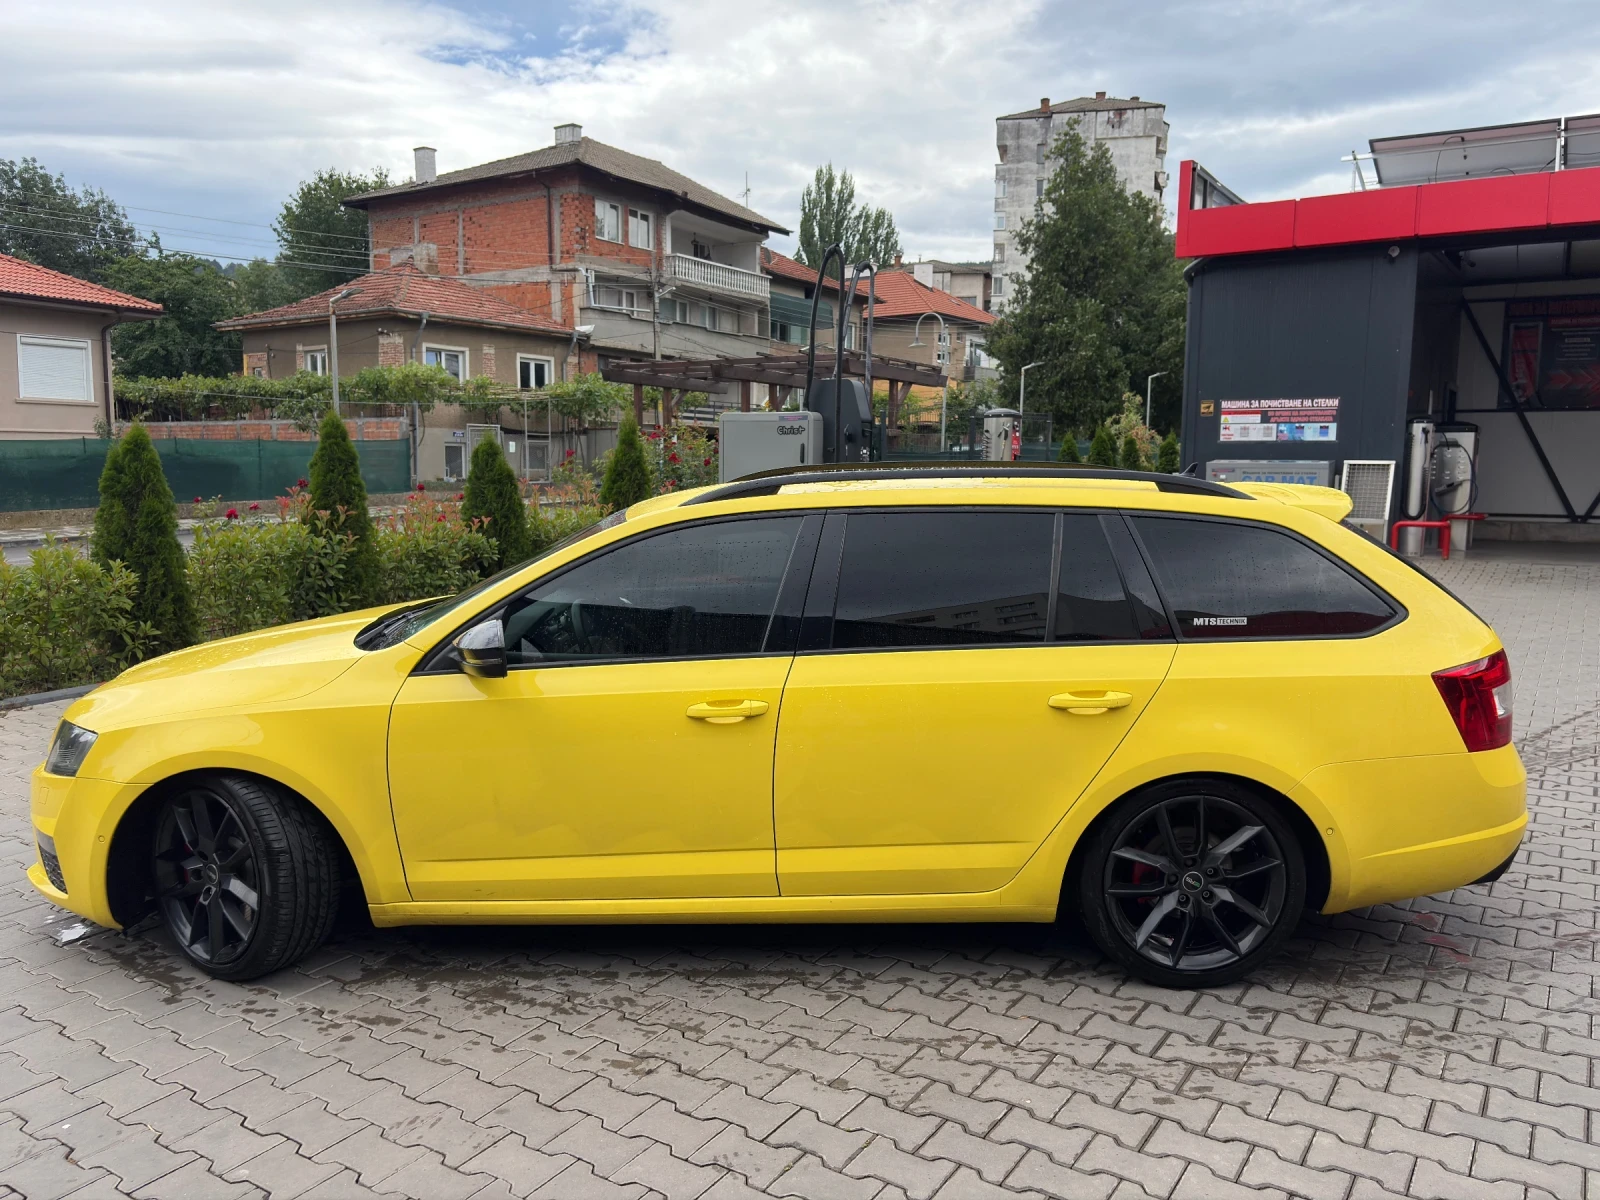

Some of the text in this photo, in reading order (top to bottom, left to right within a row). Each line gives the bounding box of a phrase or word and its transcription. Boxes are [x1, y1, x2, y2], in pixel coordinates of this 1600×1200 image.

[1221, 398, 1339, 408] МАШИНА ЗА ПОЧИСТВАНЕ НА СТЕЛКИ
[777, 425, 805, 435] Christ
[1193, 617, 1217, 626] MTS
